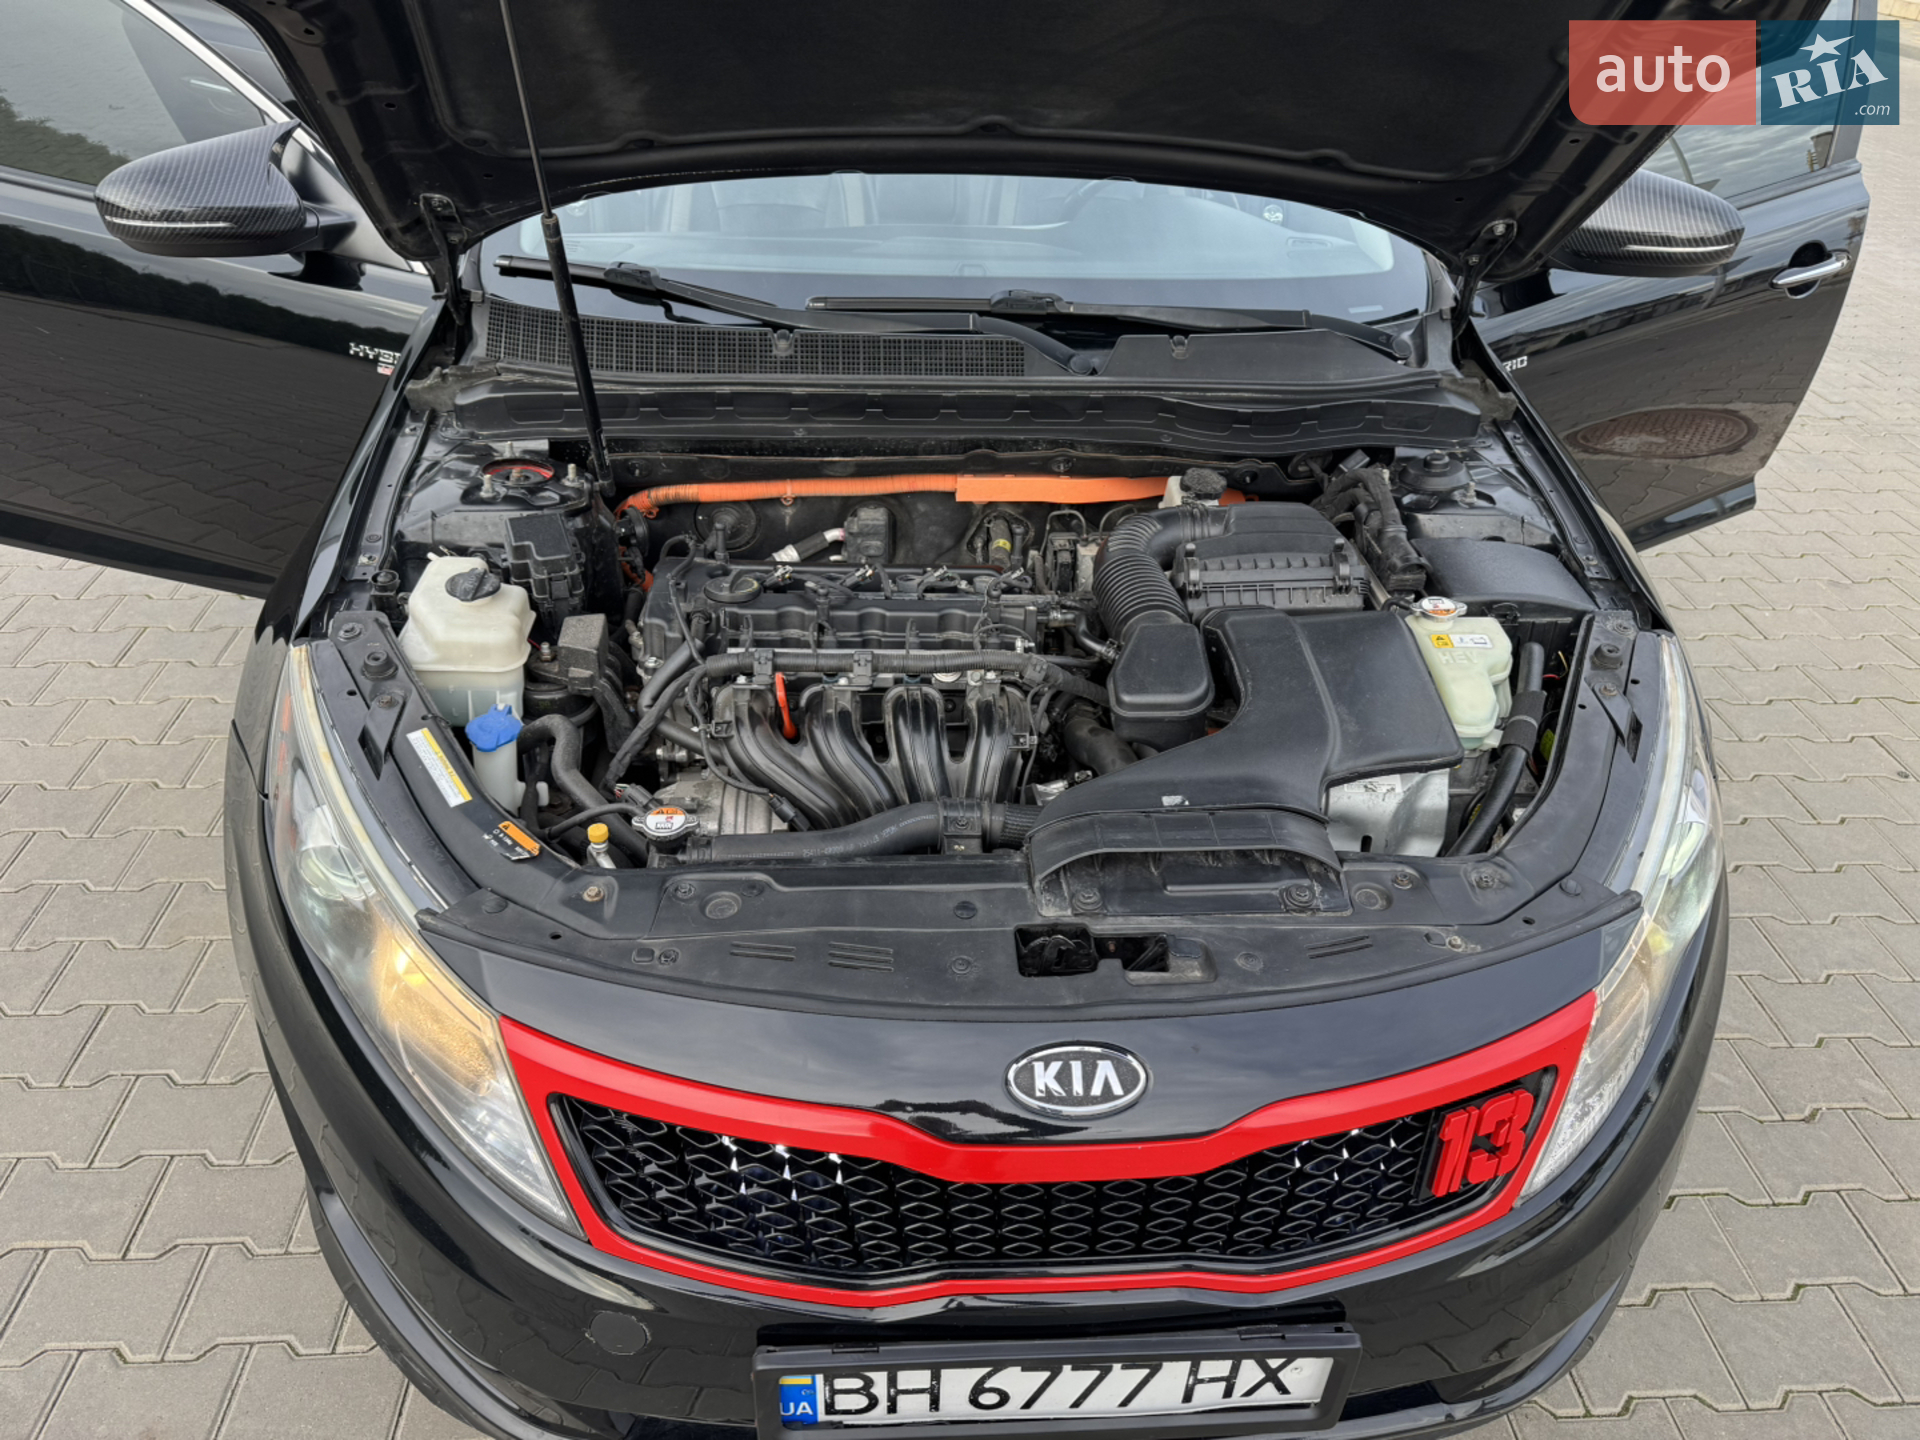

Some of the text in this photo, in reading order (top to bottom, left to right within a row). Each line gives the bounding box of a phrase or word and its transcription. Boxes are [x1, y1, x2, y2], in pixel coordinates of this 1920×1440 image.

[1032, 1060, 1124, 1097] KIA
[823, 1357, 1299, 1416] BH 6777 HX
[779, 1402, 813, 1416] UA
